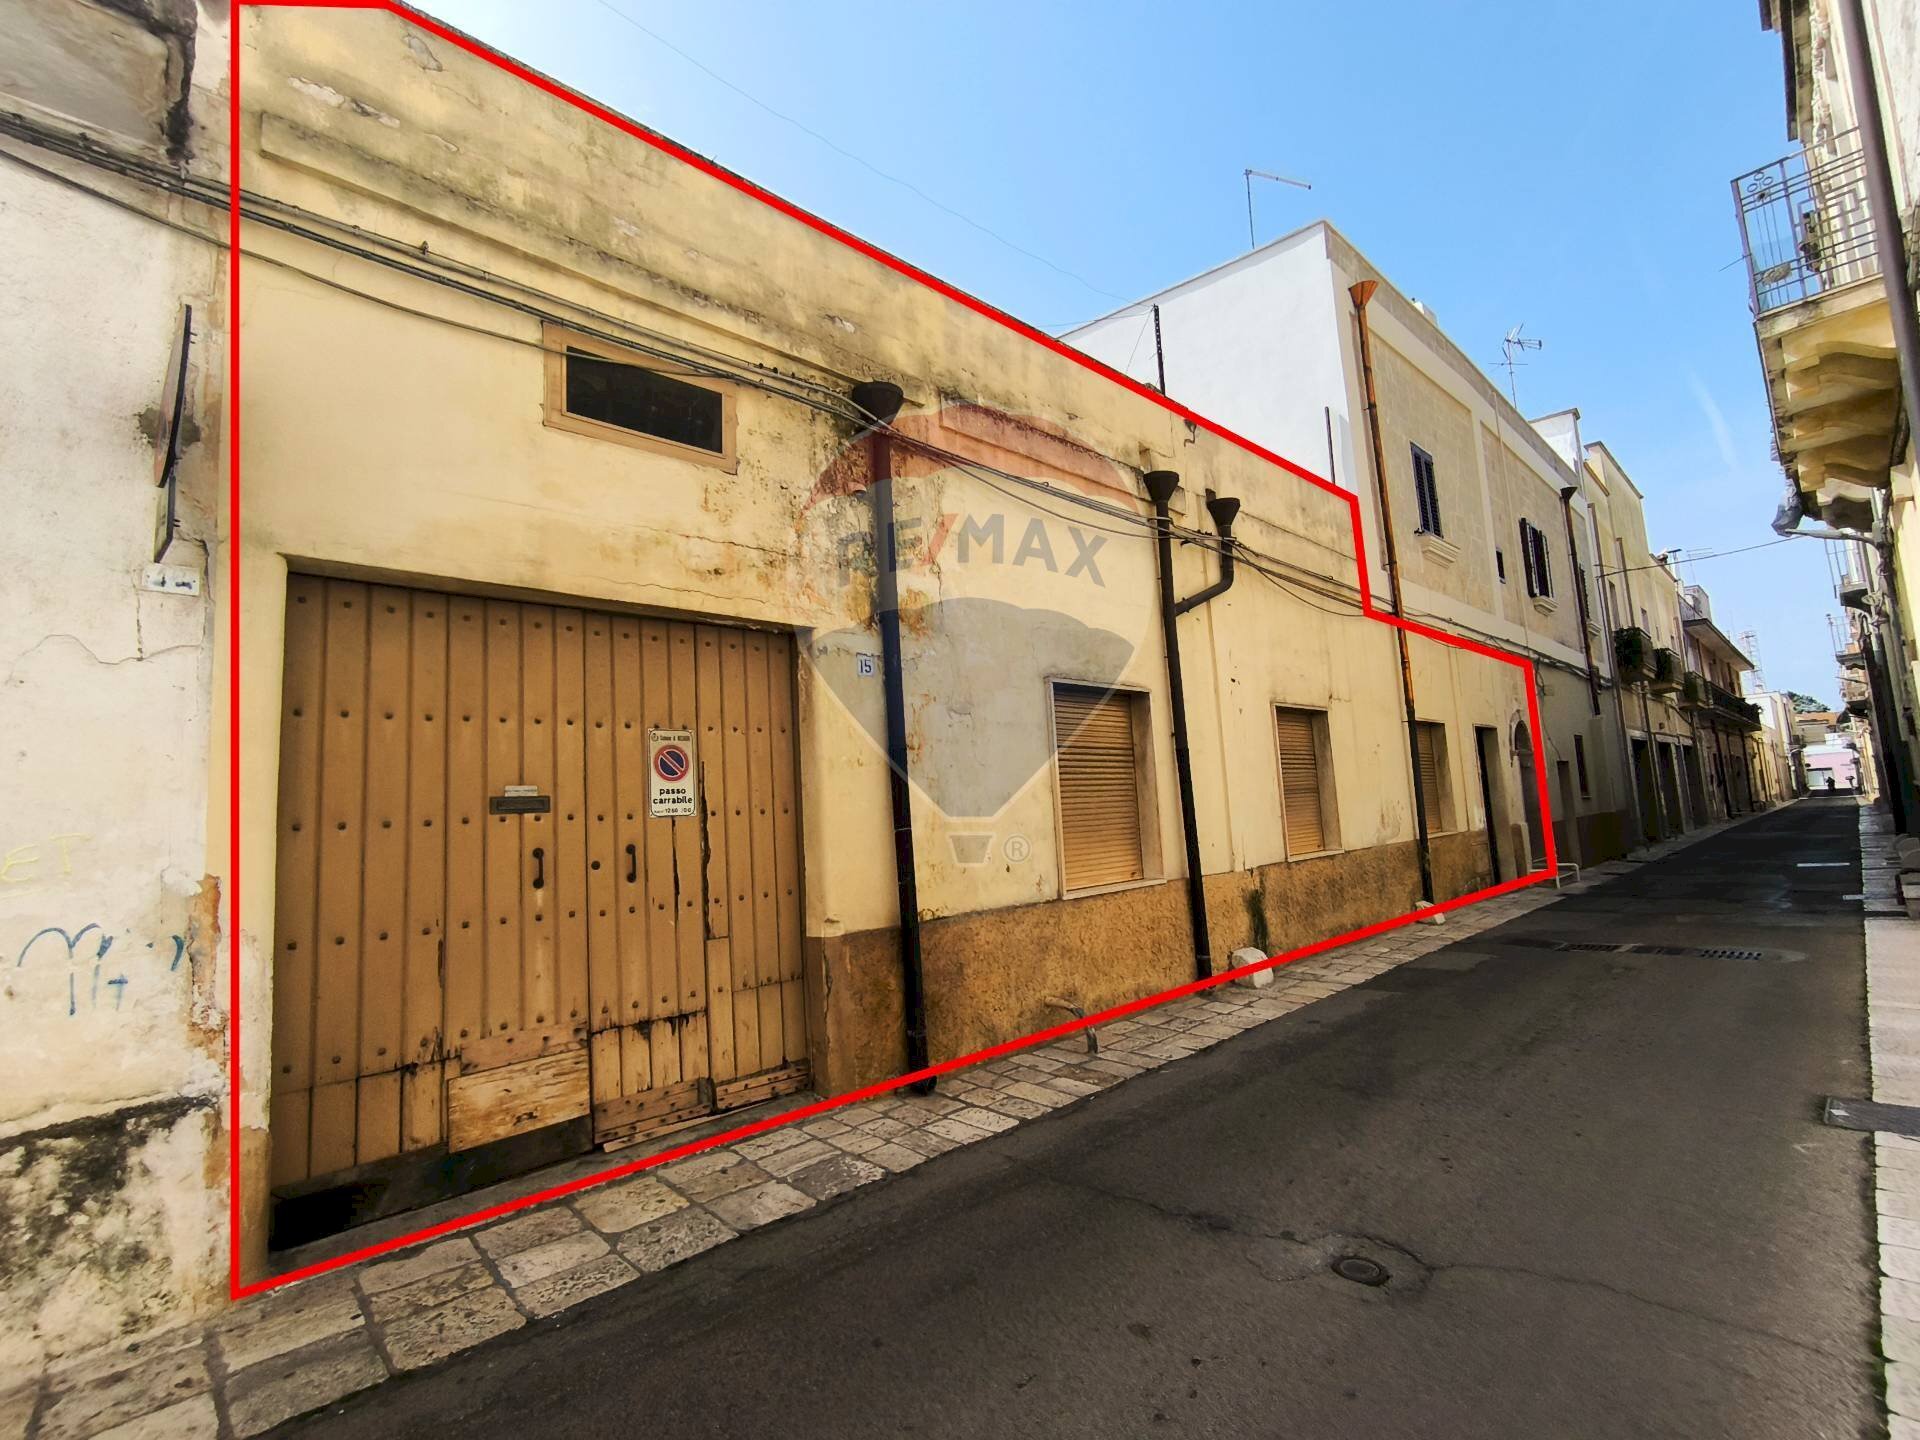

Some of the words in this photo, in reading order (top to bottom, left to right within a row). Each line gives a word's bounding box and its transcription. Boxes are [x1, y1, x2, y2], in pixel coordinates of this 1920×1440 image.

[860, 659, 872, 673] 15
[659, 788, 686, 796] passo
[652, 795, 693, 805] carrabile
